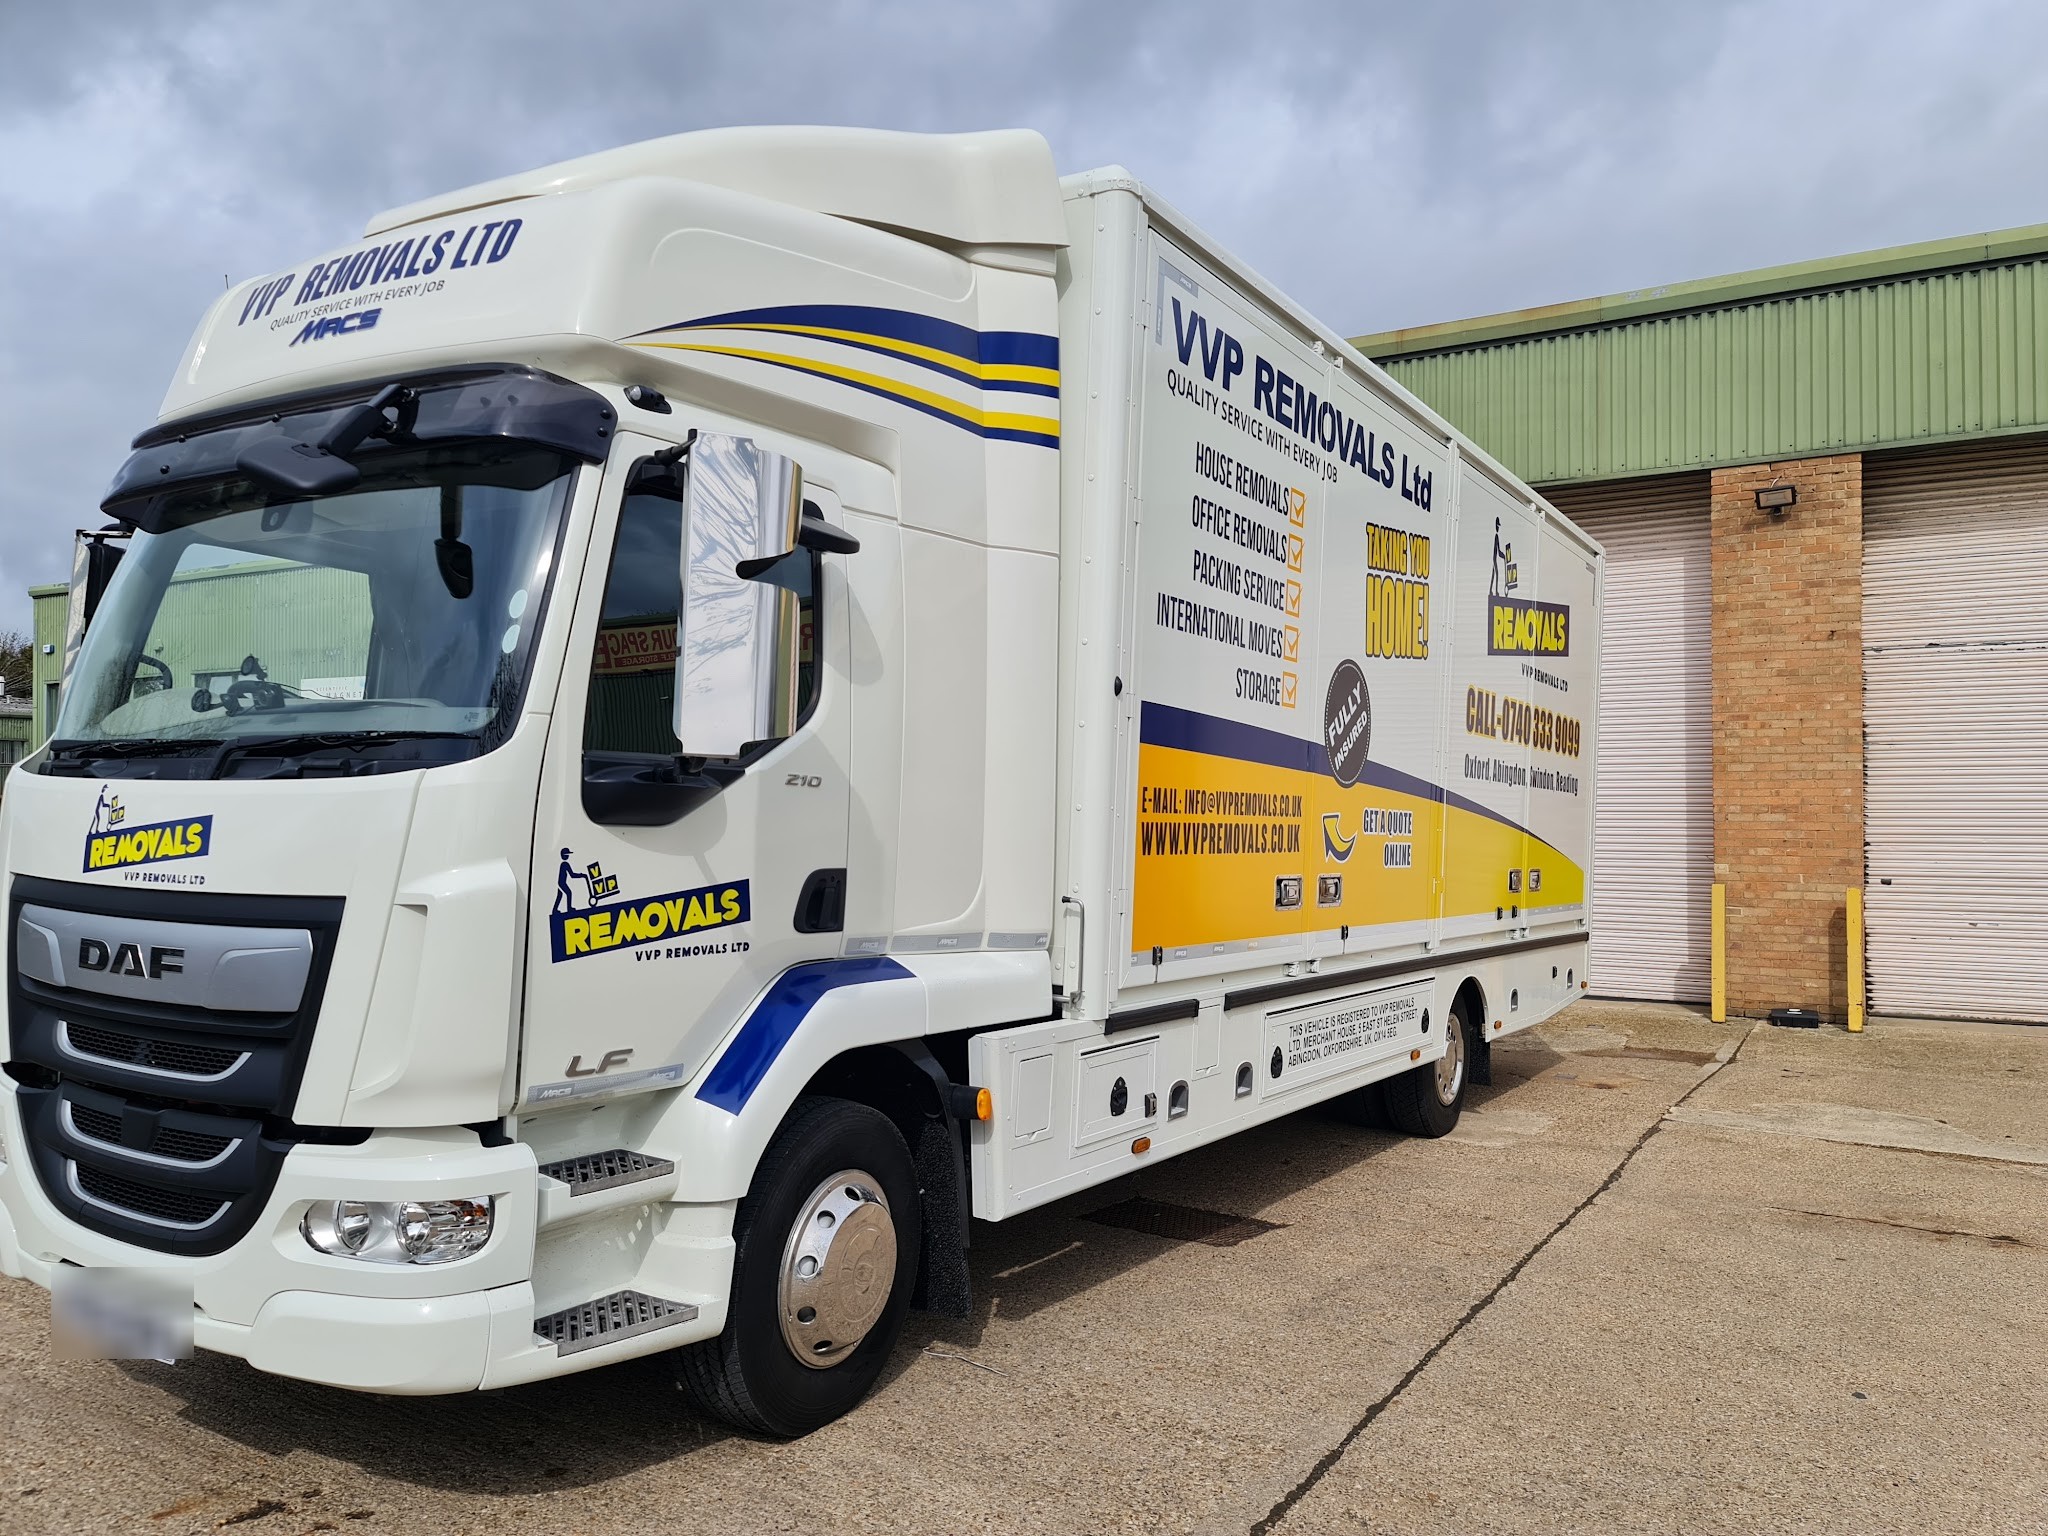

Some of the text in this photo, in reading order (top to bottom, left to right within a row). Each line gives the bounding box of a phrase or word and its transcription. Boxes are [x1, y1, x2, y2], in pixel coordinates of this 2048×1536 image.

[238, 218, 522, 326] VVP REMOVALS LTD
[270, 280, 445, 331] QUALITY SERVICE WITH EVERY JOB
[288, 308, 382, 346] MACS
[1168, 368, 1338, 482] QUALITY SERVICE WITH EVERY JOB
[1172, 296, 1432, 512] VVP REMOVALS Ltd
[1196, 441, 1289, 516] HOUSE REMOVALS
[1192, 494, 1287, 564] OFFICE REMOVALS
[1366, 522, 1430, 580] TAKING YOU
[1193, 549, 1285, 611] PACKING SERVICE
[1156, 592, 1282, 658] INTERNATIONAL MOVES
[1366, 572, 1429, 660] HOME!
[1494, 606, 1566, 652] REMOVALS
[1236, 667, 1281, 706] STORAGE
[1522, 662, 1568, 692] VVP REMOVALS LTD
[1328, 681, 1362, 748] FULLY
[1532, 706, 1553, 750] 333
[1554, 714, 1580, 758] 9099
[1334, 710, 1368, 772] INSURED
[784, 774, 822, 788] 210
[1464, 754, 1491, 782] Oxford,
[1492, 758, 1528, 788] Abingdon,
[1556, 771, 1578, 796] Reading
[1141, 786, 1302, 818] E-MAIL: INFO@VVPREMOVALS.CO.UK
[1364, 809, 1412, 836] GET A QUOTE
[89, 822, 204, 868] REMOVALS
[1141, 822, 1300, 856] WWW.VVPREMOVALS.CO.UK
[1384, 844, 1410, 866] ONLINE
[124, 872, 206, 885] VVP REMOVALS LTD
[564, 888, 740, 956] REMOVALS
[79, 936, 186, 980] DAF
[636, 942, 750, 962] VVP REMOVALS LTD
[1290, 998, 1414, 1038] THIS VEHICLE IS REGISTERED TO VVP REMOVALS
[1304, 1030, 1336, 1048] MERCHANT
[1338, 1024, 1357, 1039] HOUSE,
[1358, 1023, 1362, 1034] 5
[1363, 1020, 1376, 1032] EAST
[1377, 1018, 1383, 1028] ST
[1384, 1014, 1400, 1026] HELEN
[565, 1048, 634, 1078] LF
[1288, 1048, 1322, 1068] ABINGDON,
[1324, 1036, 1364, 1056] OXFORDSHIRE,
[1374, 1030, 1386, 1042] OX14
[540, 1087, 572, 1098] MACS
[651, 1070, 676, 1080] MACS
